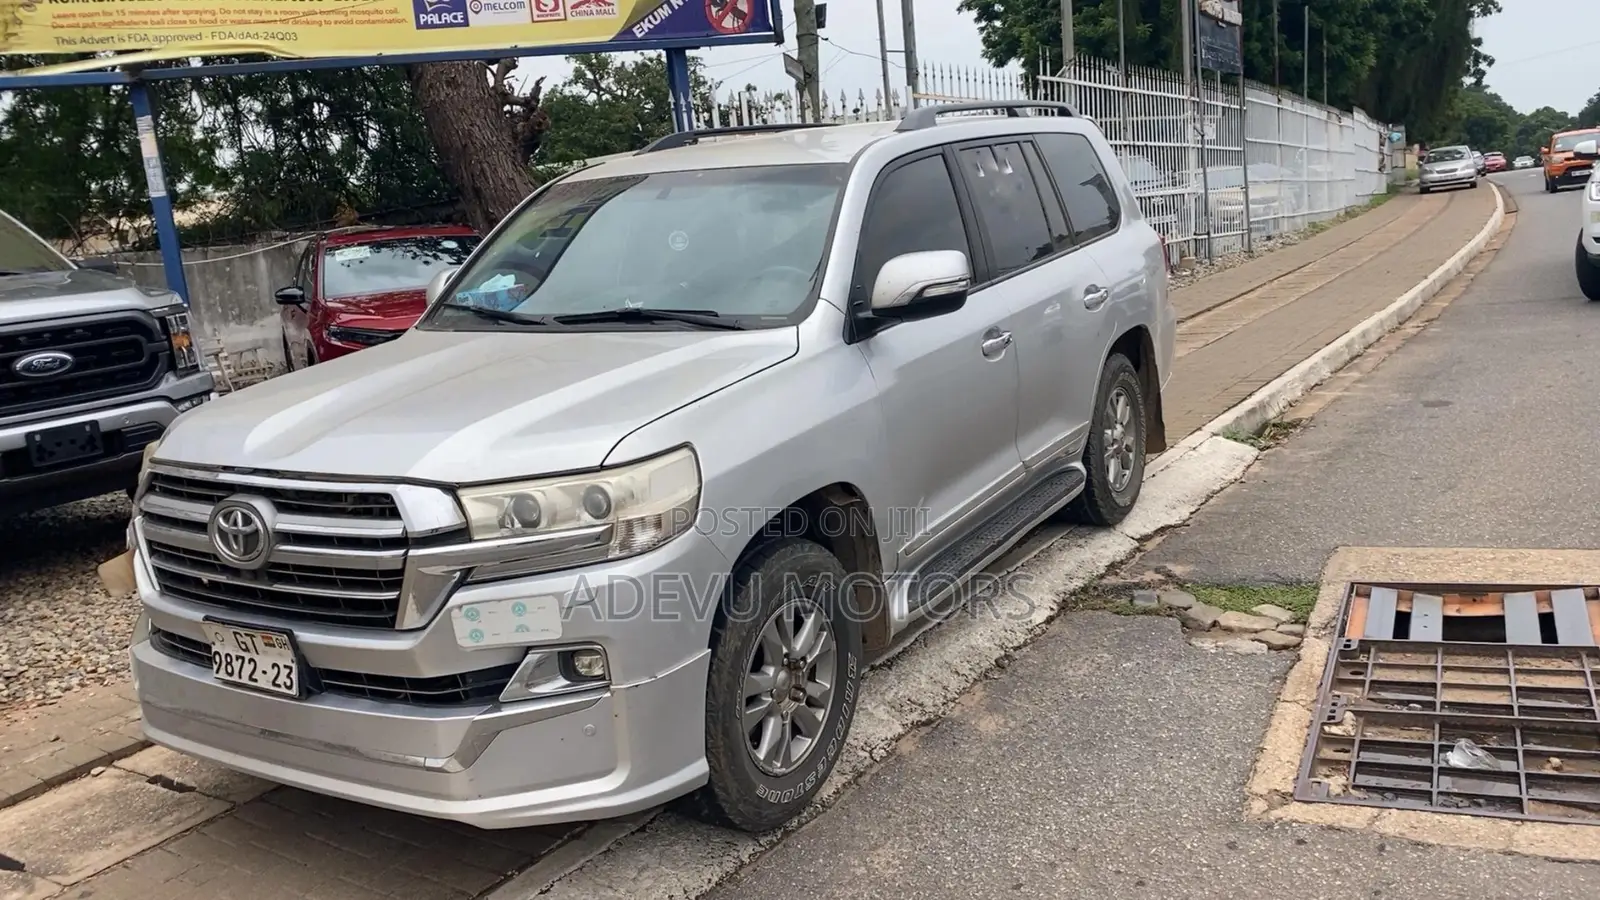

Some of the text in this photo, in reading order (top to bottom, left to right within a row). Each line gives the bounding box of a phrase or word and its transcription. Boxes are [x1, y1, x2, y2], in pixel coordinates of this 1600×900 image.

[247, 8, 263, 16] stay
[349, 8, 384, 17] mosquito
[419, 12, 465, 25] PALACE
[570, 8, 616, 18] CHINA MALL
[199, 17, 218, 25] food
[291, 18, 323, 27] drinking
[355, 17, 408, 25] contamination.
[631, 3, 673, 39] EKUM
[54, 36, 77, 46] This
[79, 35, 115, 45] Advert
[117, 34, 126, 43] is
[127, 33, 151, 43] FDA
[152, 31, 203, 45] approved
[210, 31, 298, 41] FDA/dAd-24Q03
[232, 630, 291, 656] GT GH
[212, 650, 294, 691] 9872-23
